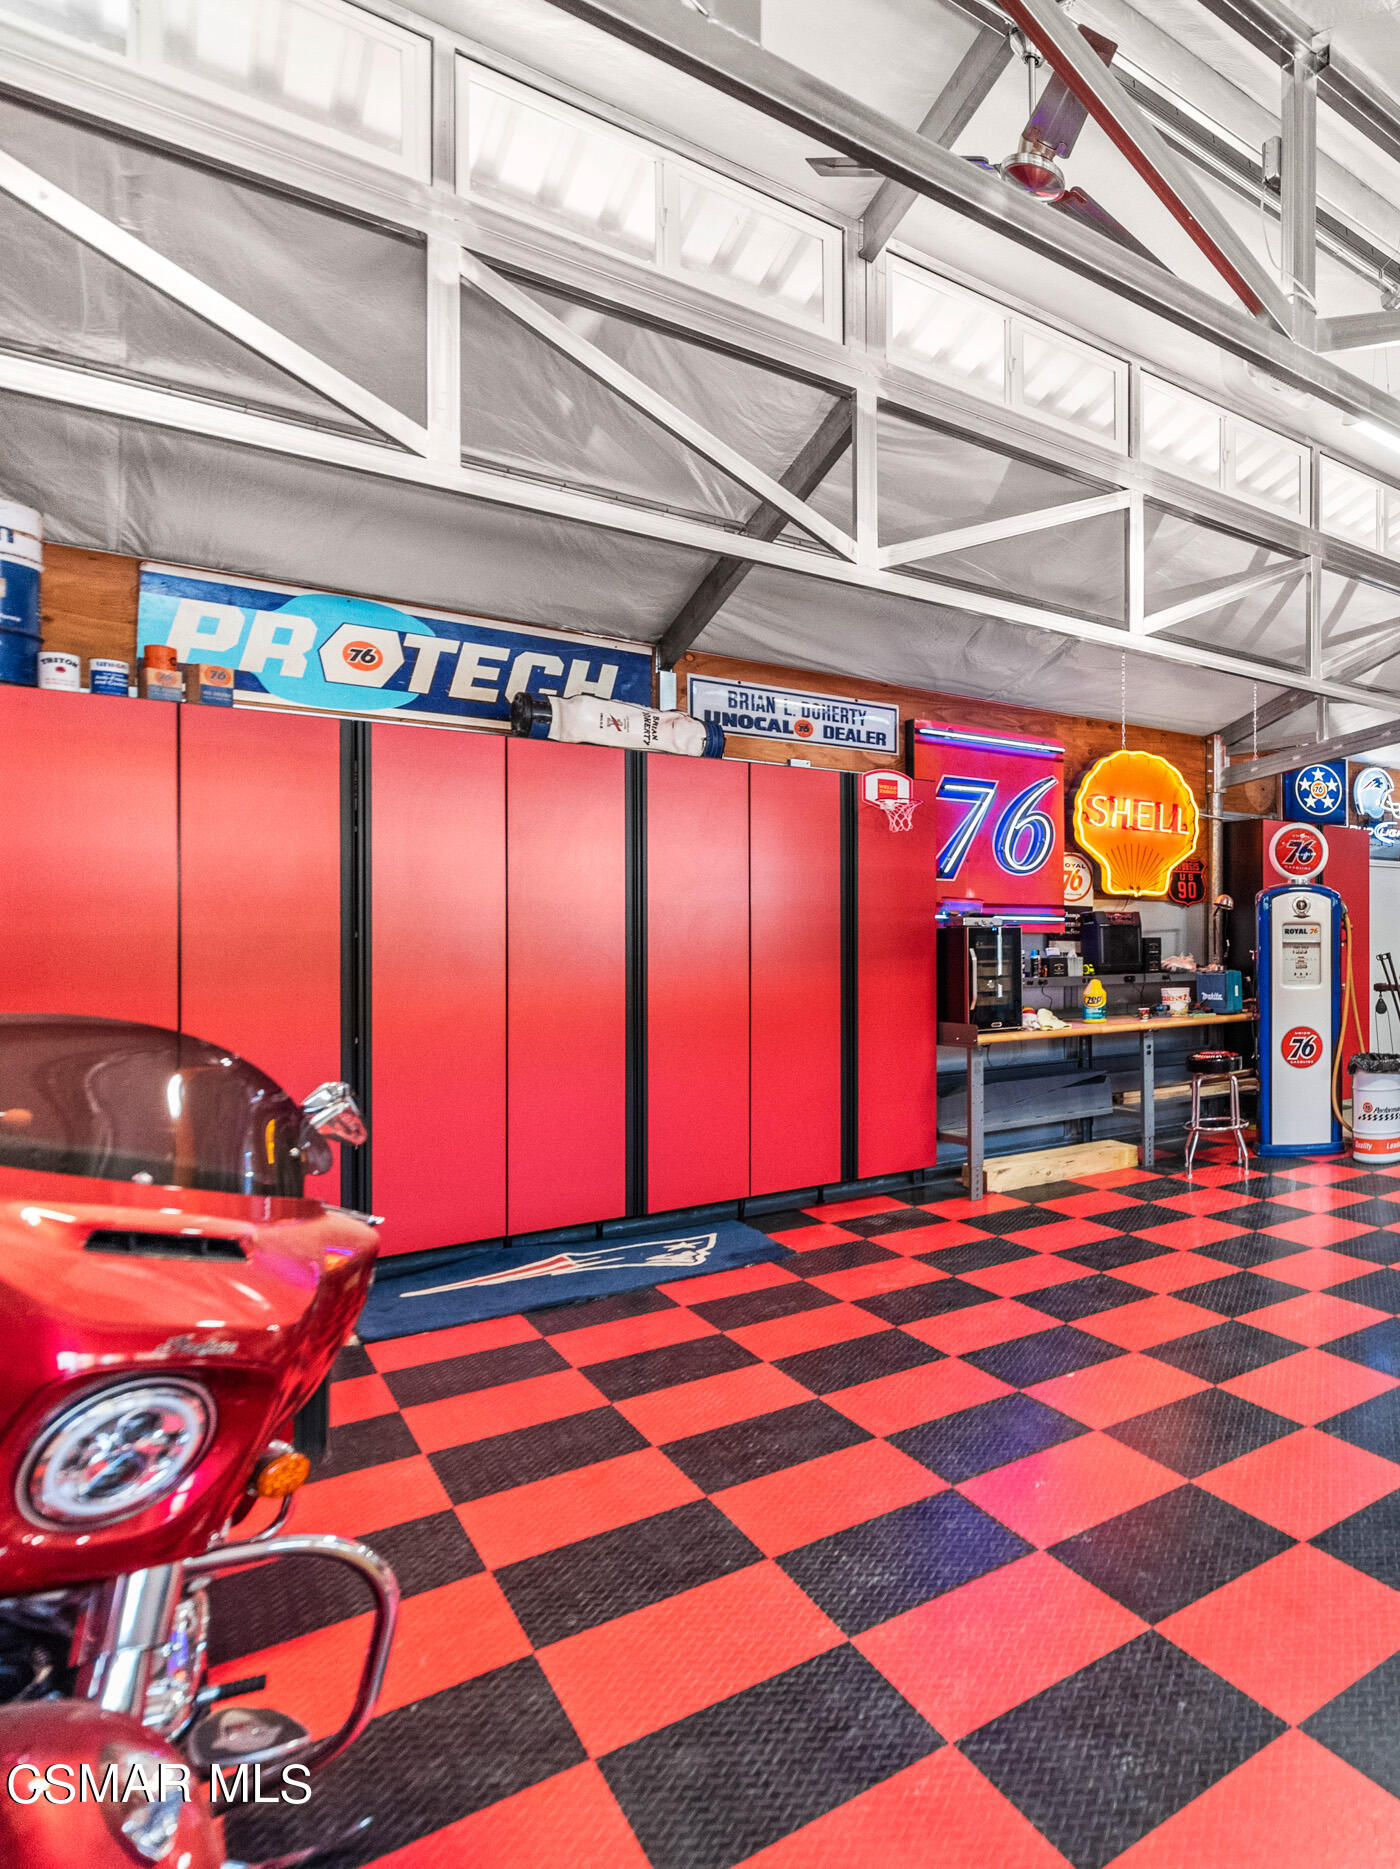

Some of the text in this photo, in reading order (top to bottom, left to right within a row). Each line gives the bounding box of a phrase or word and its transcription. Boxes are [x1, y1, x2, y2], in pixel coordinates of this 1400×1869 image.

[41, 657, 78, 667] TRITON
[348, 648, 377, 664] 76
[210, 670, 226, 680] 76
[728, 690, 775, 713] BRIAN
[801, 701, 867, 726] DOHERTY
[652, 715, 660, 741] BRIAN
[704, 710, 794, 734] UNOCAL
[823, 725, 887, 746] DEALER
[1086, 794, 1190, 835] SHELL
[935, 774, 1059, 881] 76
[1282, 840, 1317, 865] 76
[1064, 869, 1083, 891] 76
[1178, 881, 1197, 899] 90
[1287, 1034, 1317, 1060] 76
